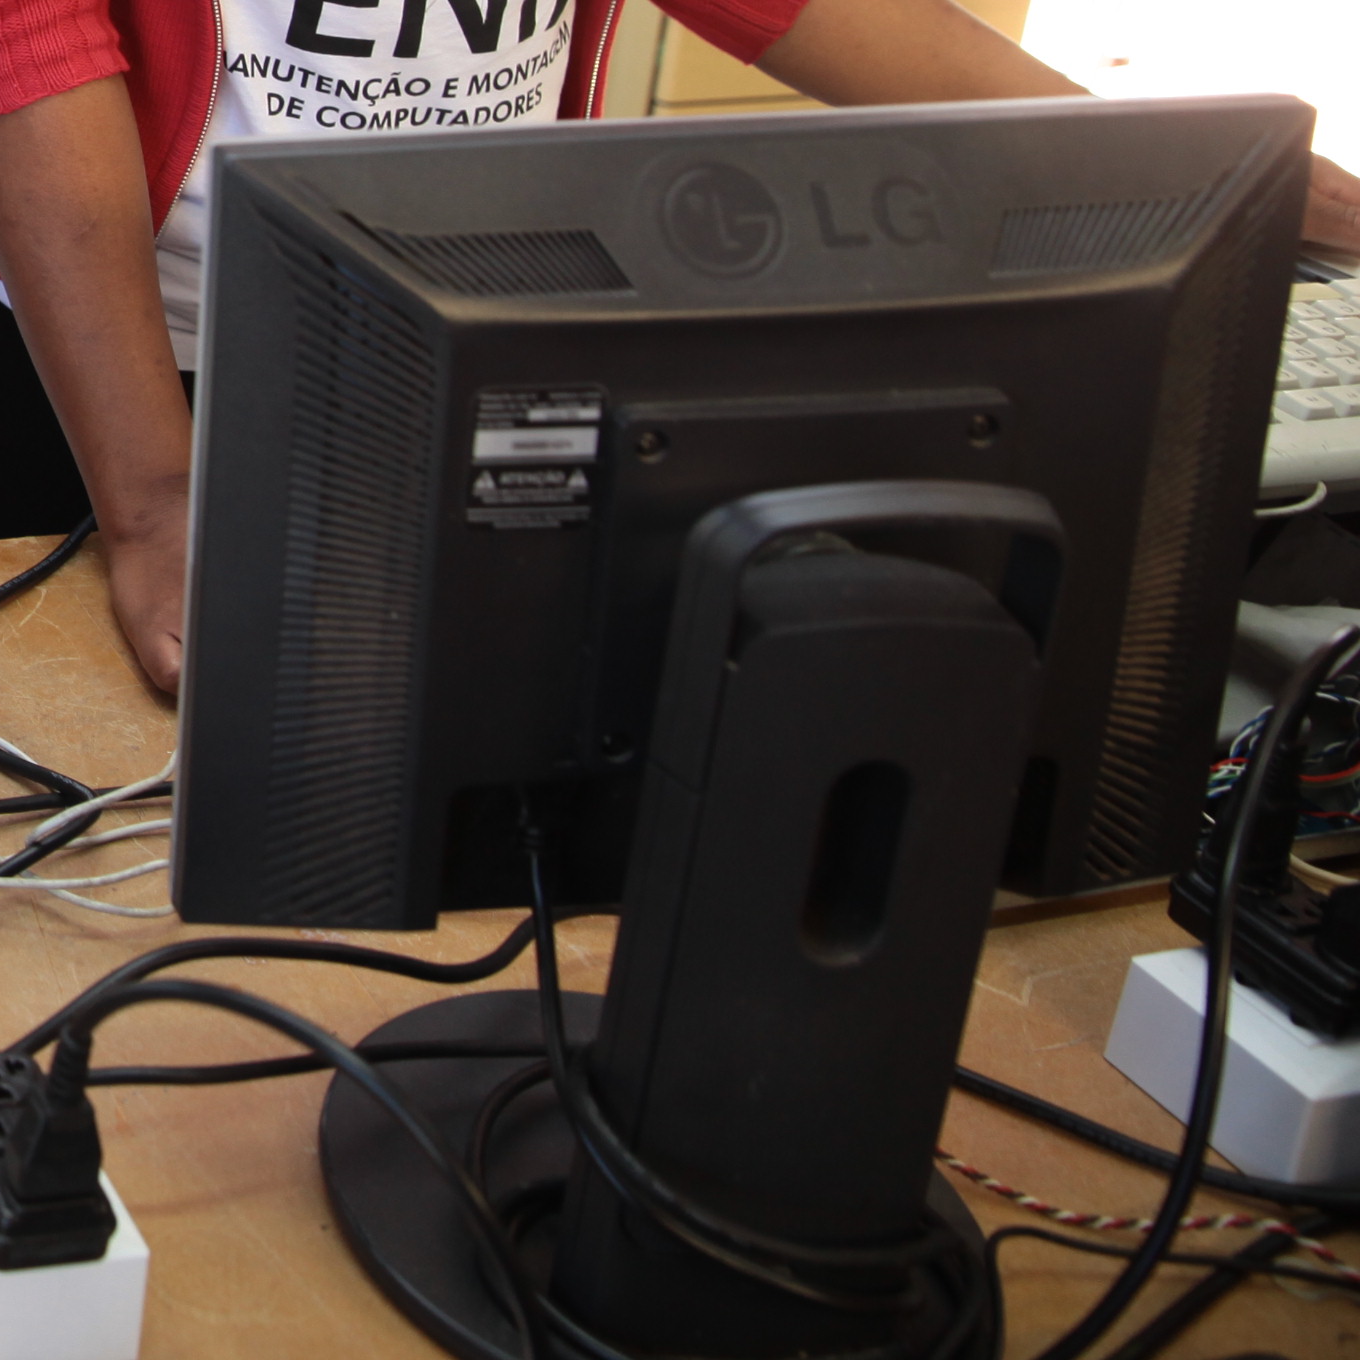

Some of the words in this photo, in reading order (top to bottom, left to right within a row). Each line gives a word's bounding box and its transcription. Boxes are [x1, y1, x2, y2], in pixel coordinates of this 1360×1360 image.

[223, 49, 431, 107] ANUTENÇÃO
[442, 77, 459, 98] E
[267, 92, 306, 120] DE
[316, 83, 542, 130] COMPUTADORES
[810, 176, 943, 250] LG
